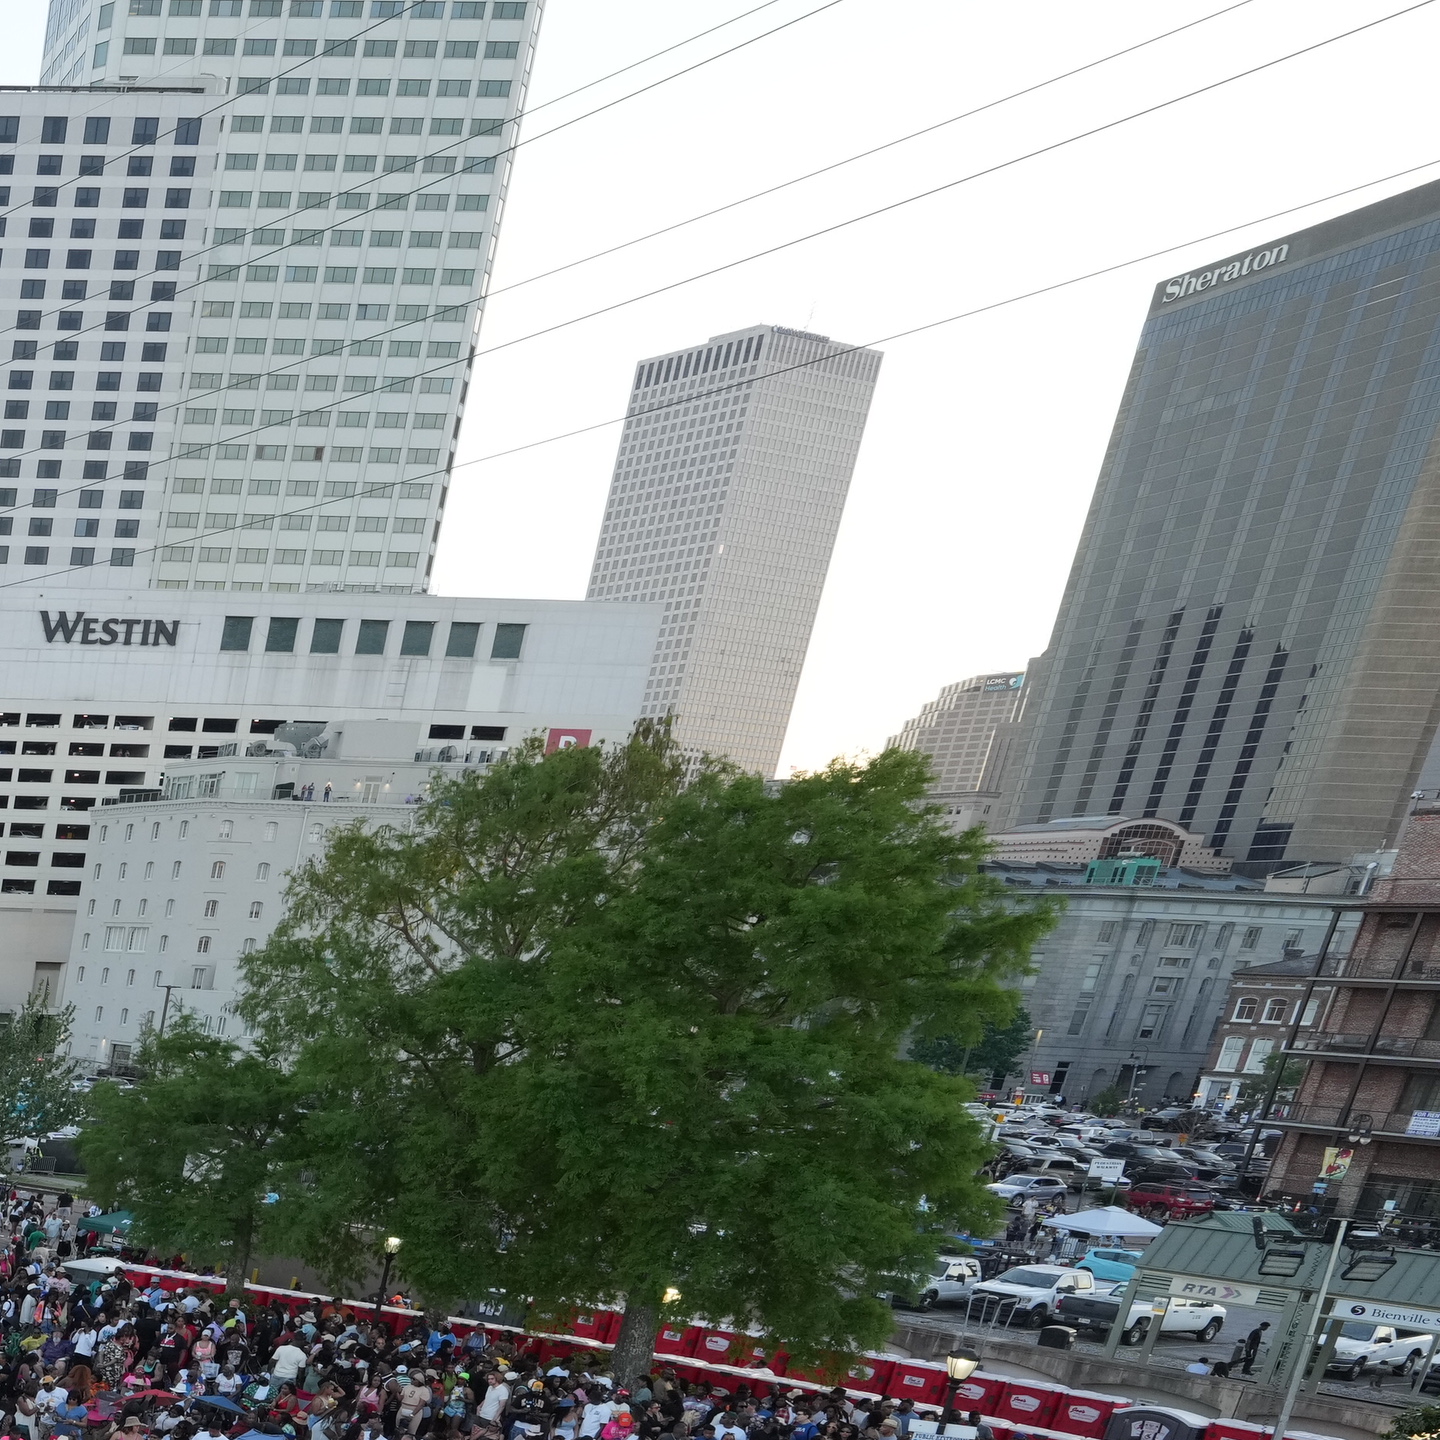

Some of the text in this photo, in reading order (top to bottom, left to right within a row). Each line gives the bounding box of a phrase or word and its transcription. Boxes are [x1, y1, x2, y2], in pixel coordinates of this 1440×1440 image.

[1162, 243, 1289, 304] Sheraton
[39, 610, 180, 647] WESTIN
[1181, 1282, 1218, 1297] RTA
[1371, 1308, 1431, 1327] Bienville
